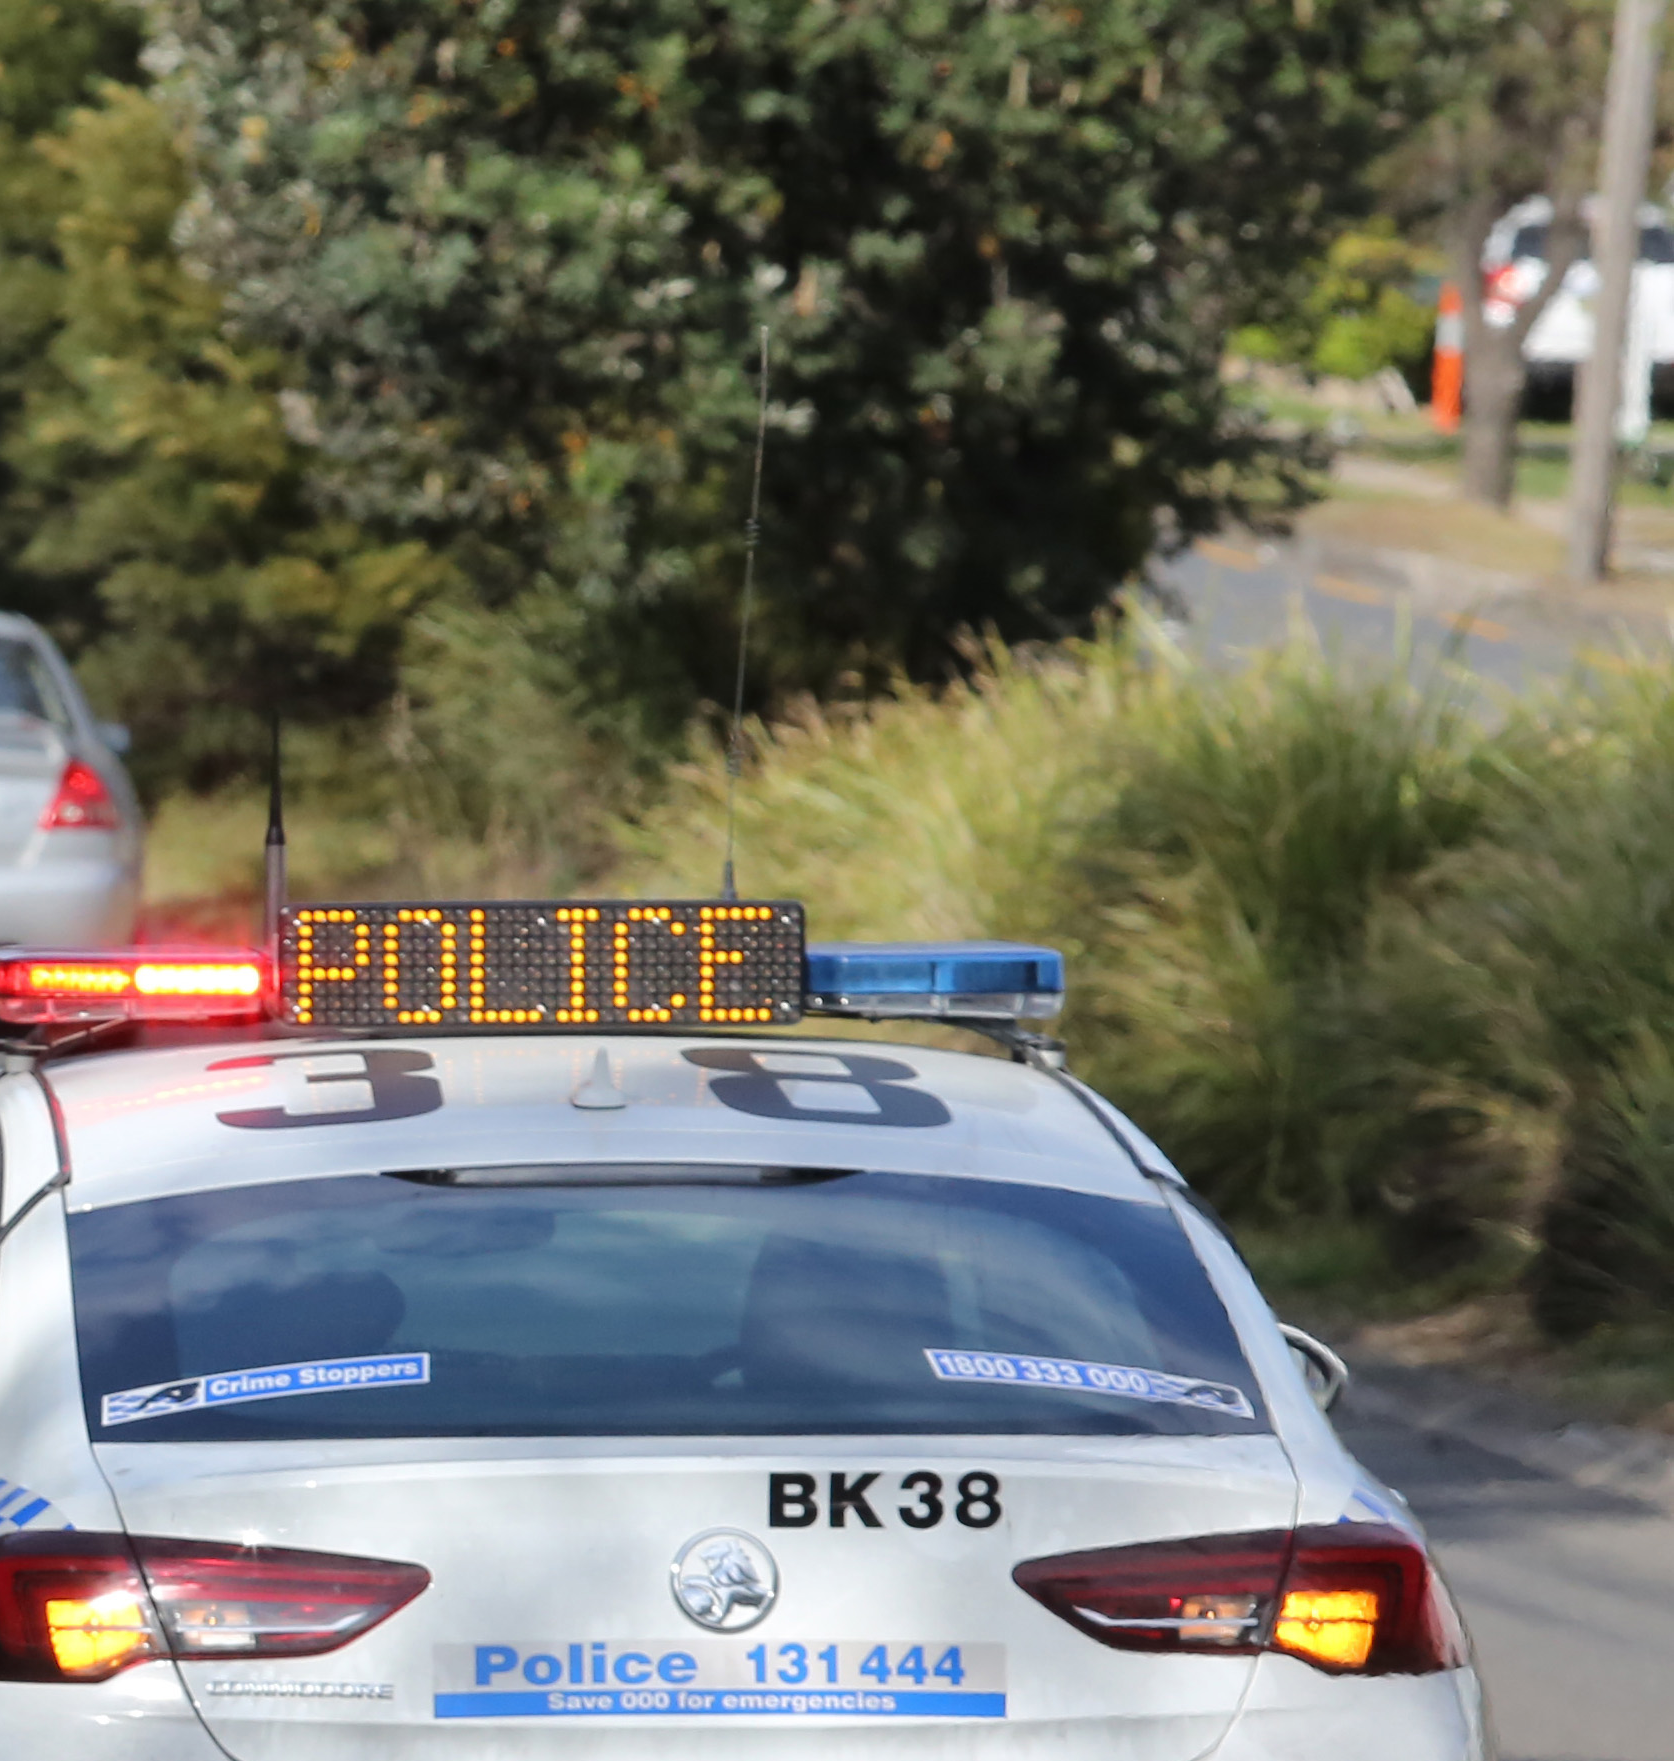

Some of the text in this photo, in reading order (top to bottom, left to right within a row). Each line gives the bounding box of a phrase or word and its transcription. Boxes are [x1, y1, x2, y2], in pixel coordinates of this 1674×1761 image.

[297, 907, 773, 1024] POLICE
[210, 1361, 419, 1396] Crime Stoppers
[939, 1354, 1151, 1394] 1800 333 000
[474, 1642, 965, 1686] Police 131 444
[548, 1690, 896, 1715] Save 000 for emergencies
